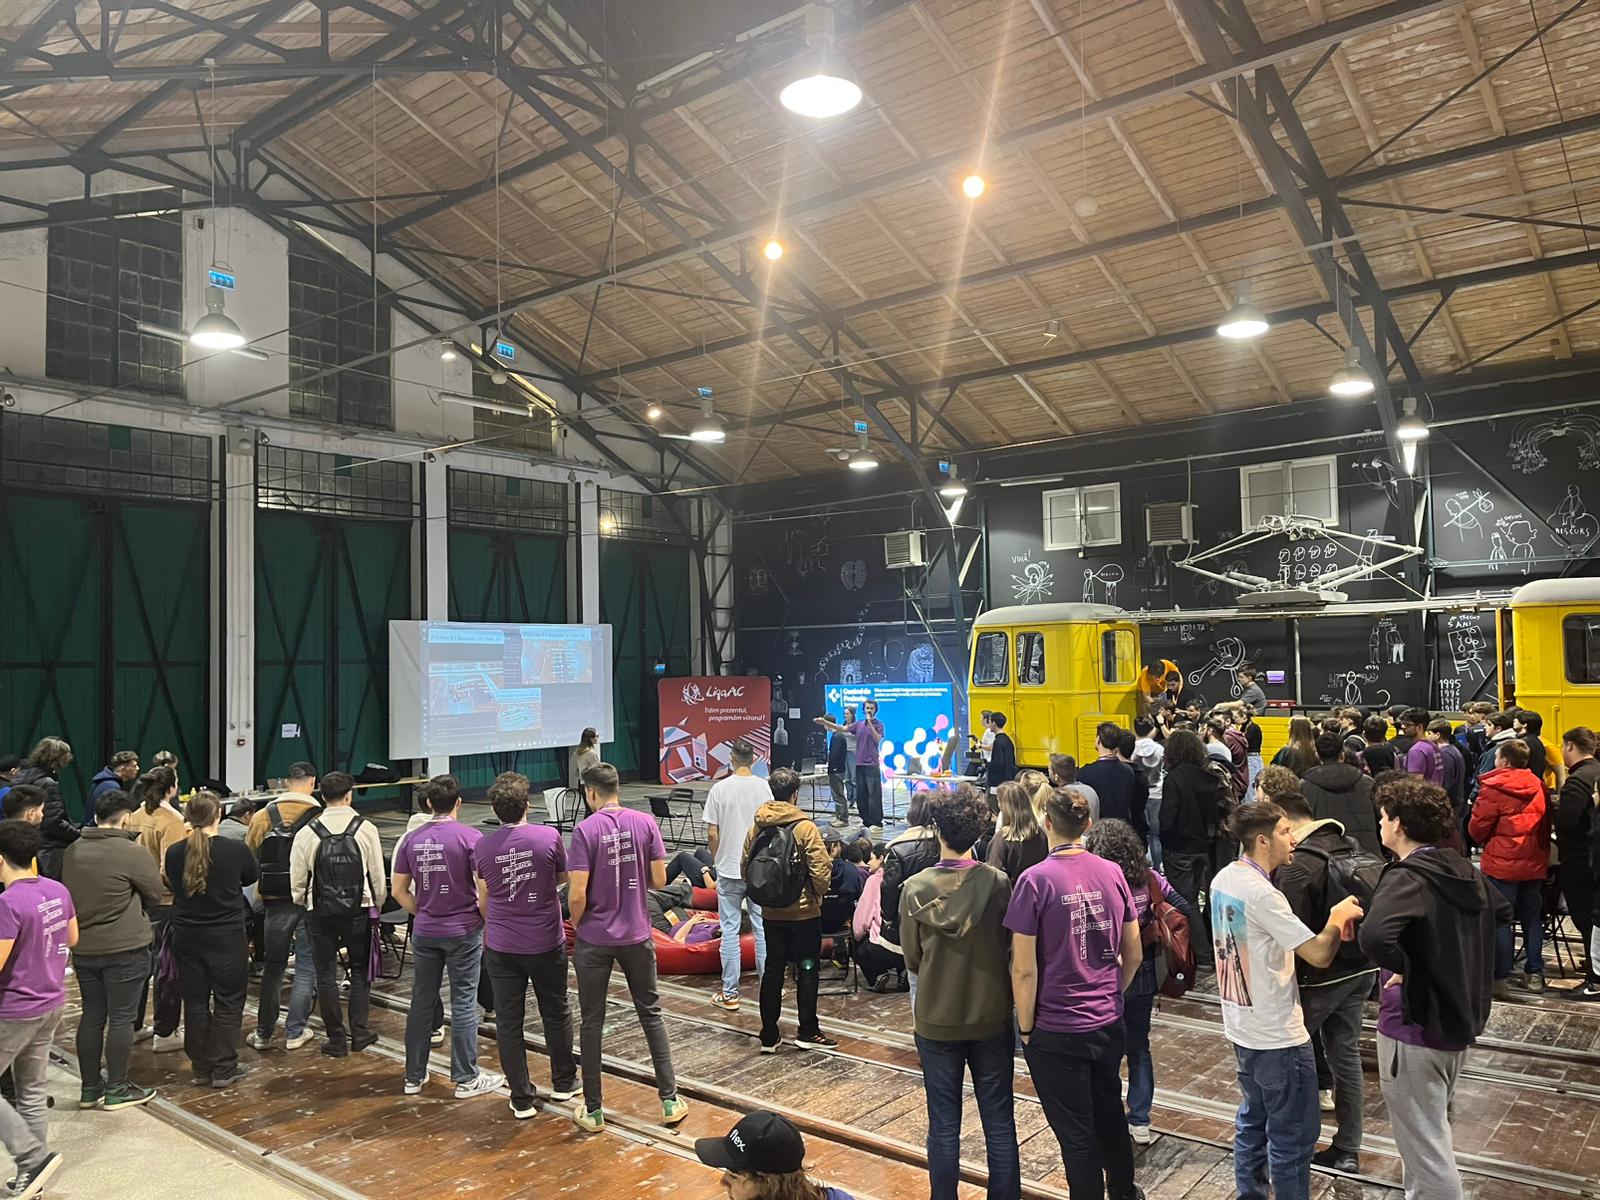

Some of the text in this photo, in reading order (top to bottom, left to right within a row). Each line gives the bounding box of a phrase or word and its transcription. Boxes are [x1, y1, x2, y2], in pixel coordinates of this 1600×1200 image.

[1555, 527, 1590, 537] DISCURS
[1439, 678, 1462, 689] 1995
[1440, 689, 1461, 698] 1996
[729, 1128, 747, 1153] flex
